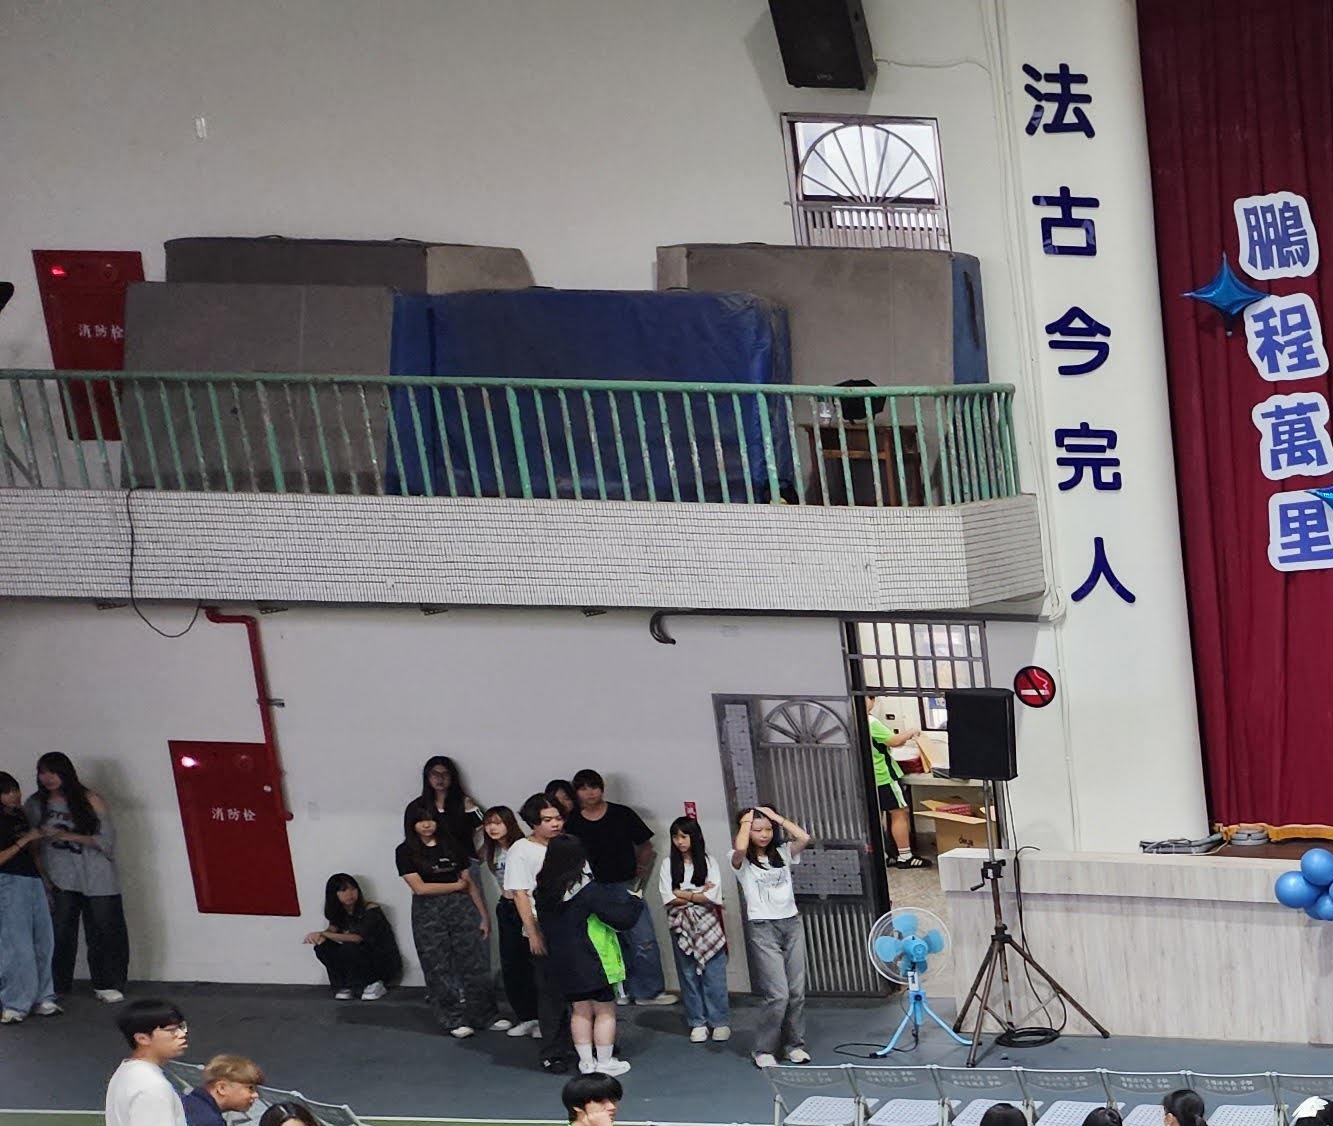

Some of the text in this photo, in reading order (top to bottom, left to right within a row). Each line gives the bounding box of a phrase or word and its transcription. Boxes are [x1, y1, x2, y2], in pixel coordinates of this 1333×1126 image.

[1022, 62, 1136, 605] 法古今完人
[211, 807, 256, 822] 消防栓
